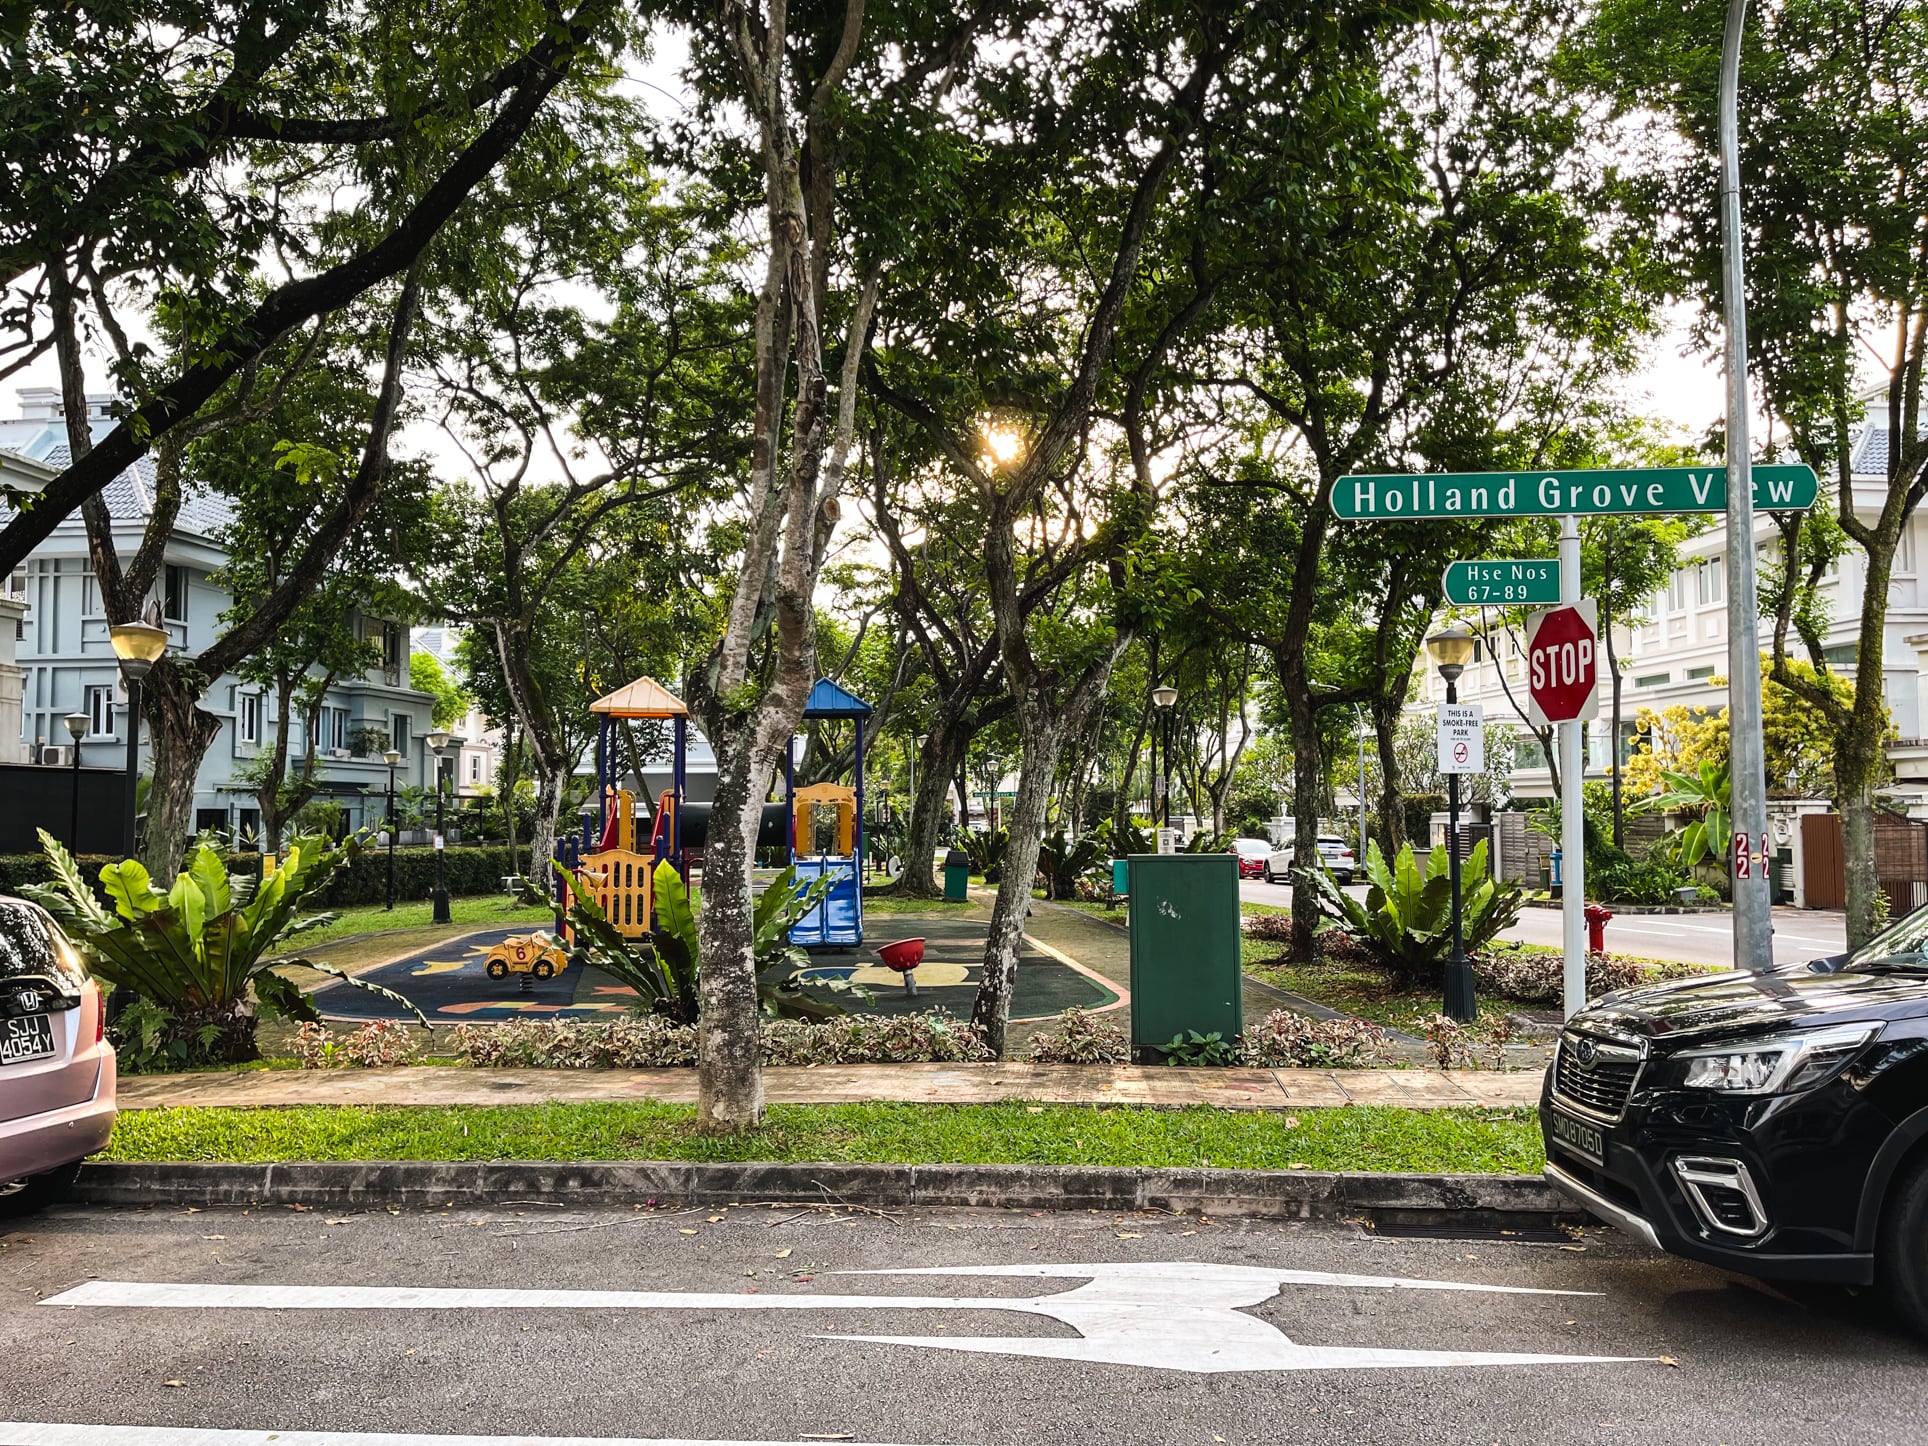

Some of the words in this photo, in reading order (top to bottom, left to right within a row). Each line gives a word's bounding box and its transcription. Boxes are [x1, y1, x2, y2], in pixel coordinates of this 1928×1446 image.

[1354, 479, 1515, 512] Holland
[1538, 477, 1664, 509] Grove
[1467, 565, 1502, 581] Hse
[1511, 564, 1547, 580] Nos
[1468, 585, 1528, 600] 67-89
[1532, 638, 1593, 690] STOP
[1442, 719, 1478, 727] SMOKE-FREE
[516, 946, 526, 960] 6
[7, 1017, 40, 1038] SJJ
[2, 1033, 51, 1058] 4054Y
